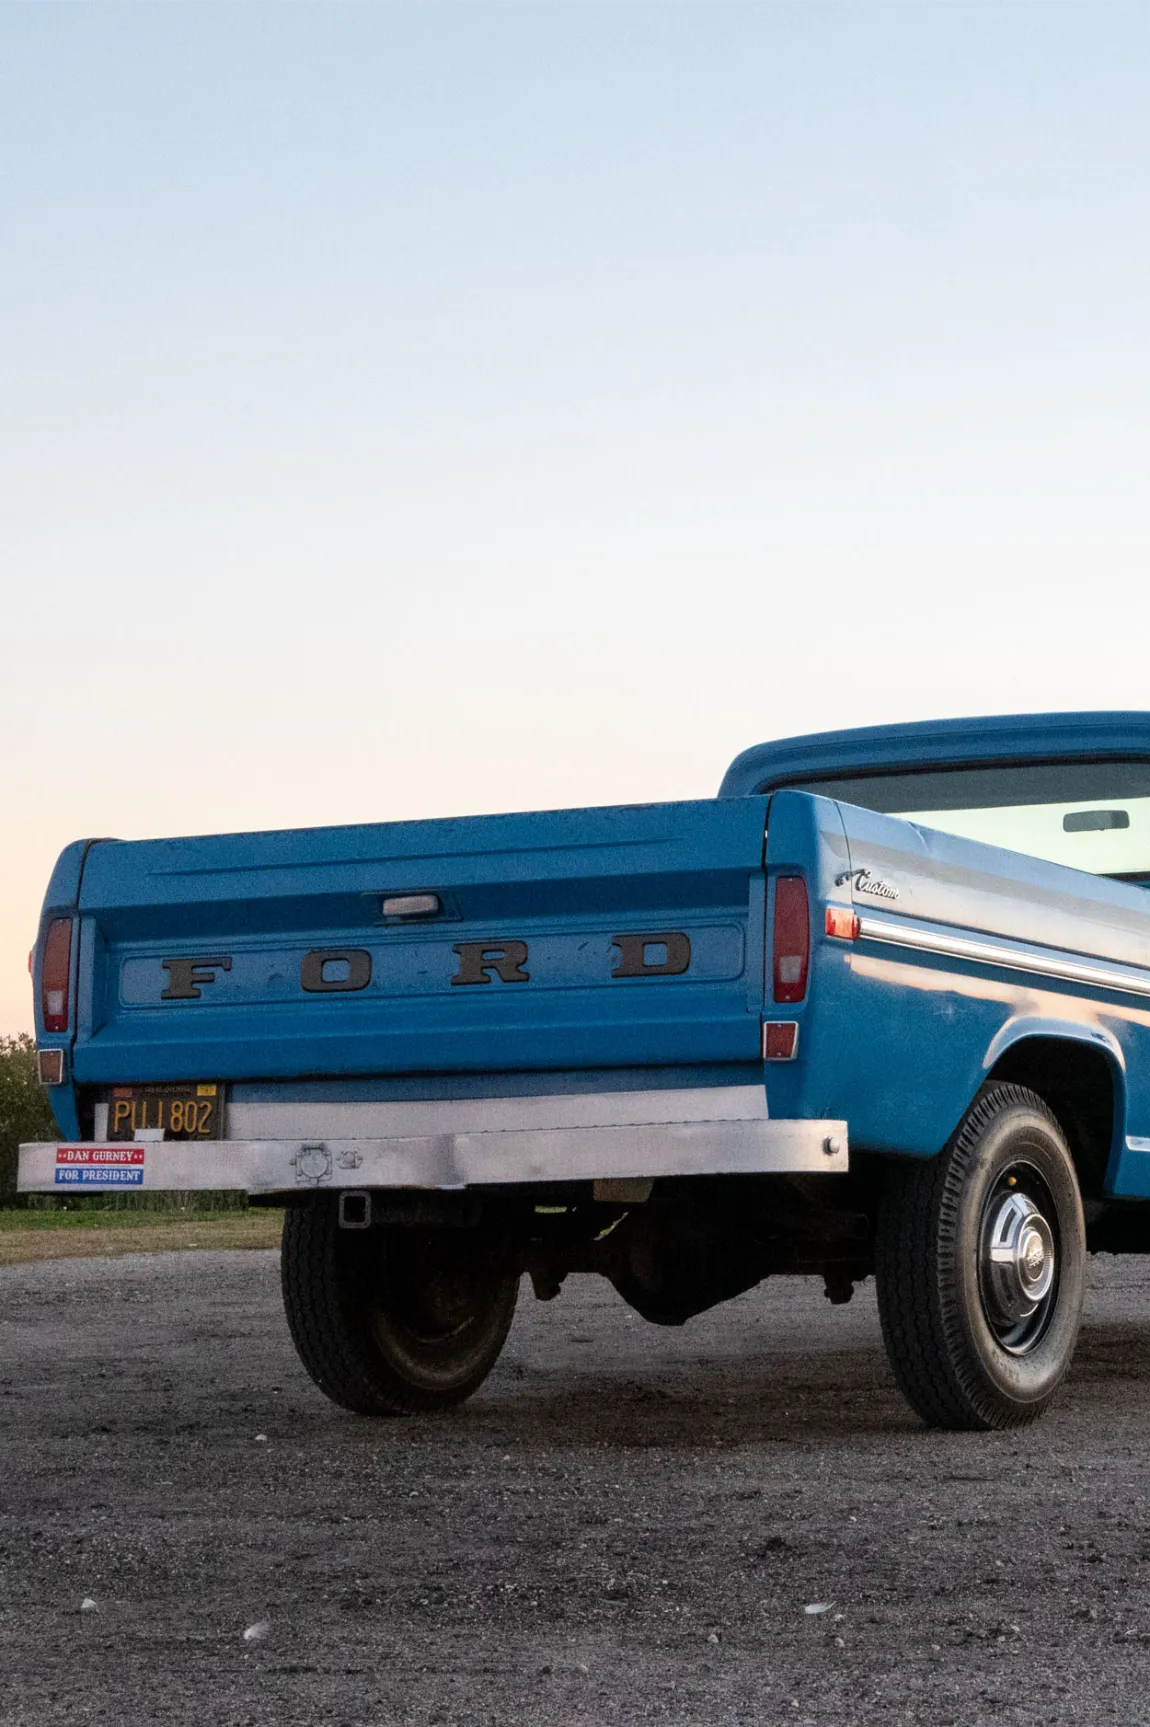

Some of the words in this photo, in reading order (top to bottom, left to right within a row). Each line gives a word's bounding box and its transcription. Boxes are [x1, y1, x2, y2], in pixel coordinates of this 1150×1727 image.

[854, 869, 899, 899] Custom
[160, 932, 691, 1000] FORD
[170, 1100, 212, 1133] 802
[67, 1151, 90, 1161] DAN
[92, 1151, 134, 1161] GURNEY
[58, 1170, 79, 1180] FOR
[82, 1170, 141, 1181] PRESIDENT
